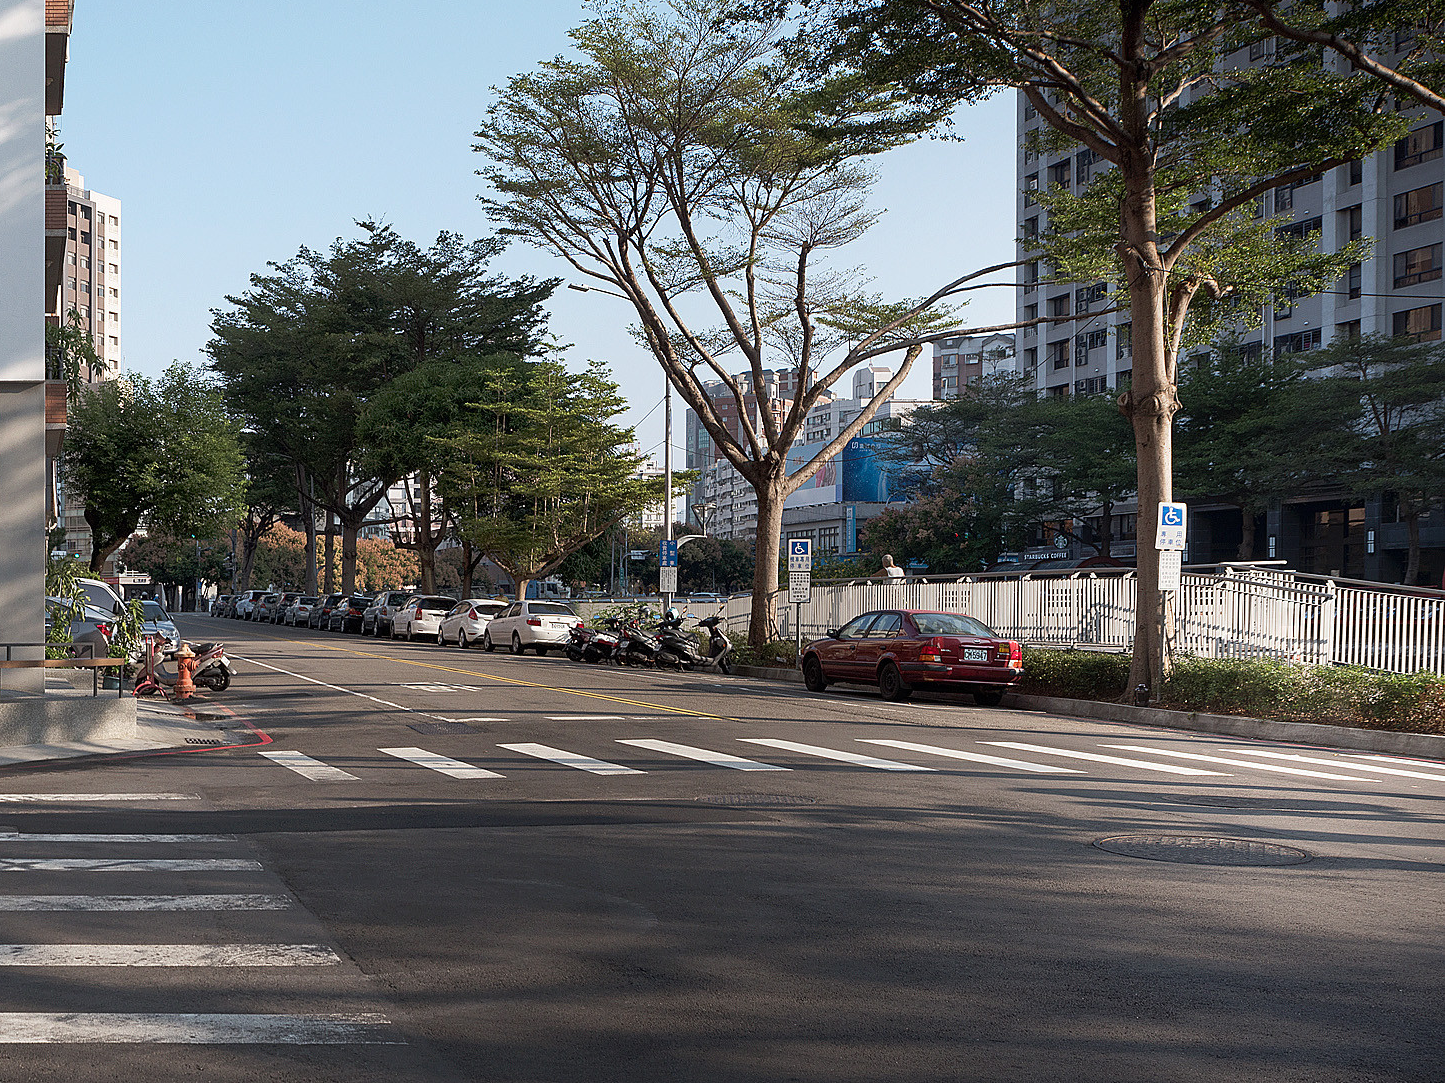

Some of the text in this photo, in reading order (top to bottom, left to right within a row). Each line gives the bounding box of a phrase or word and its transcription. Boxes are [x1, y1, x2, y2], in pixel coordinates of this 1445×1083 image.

[1161, 530, 1183, 538] 專用
[1159, 538, 1182, 547] 停車位
